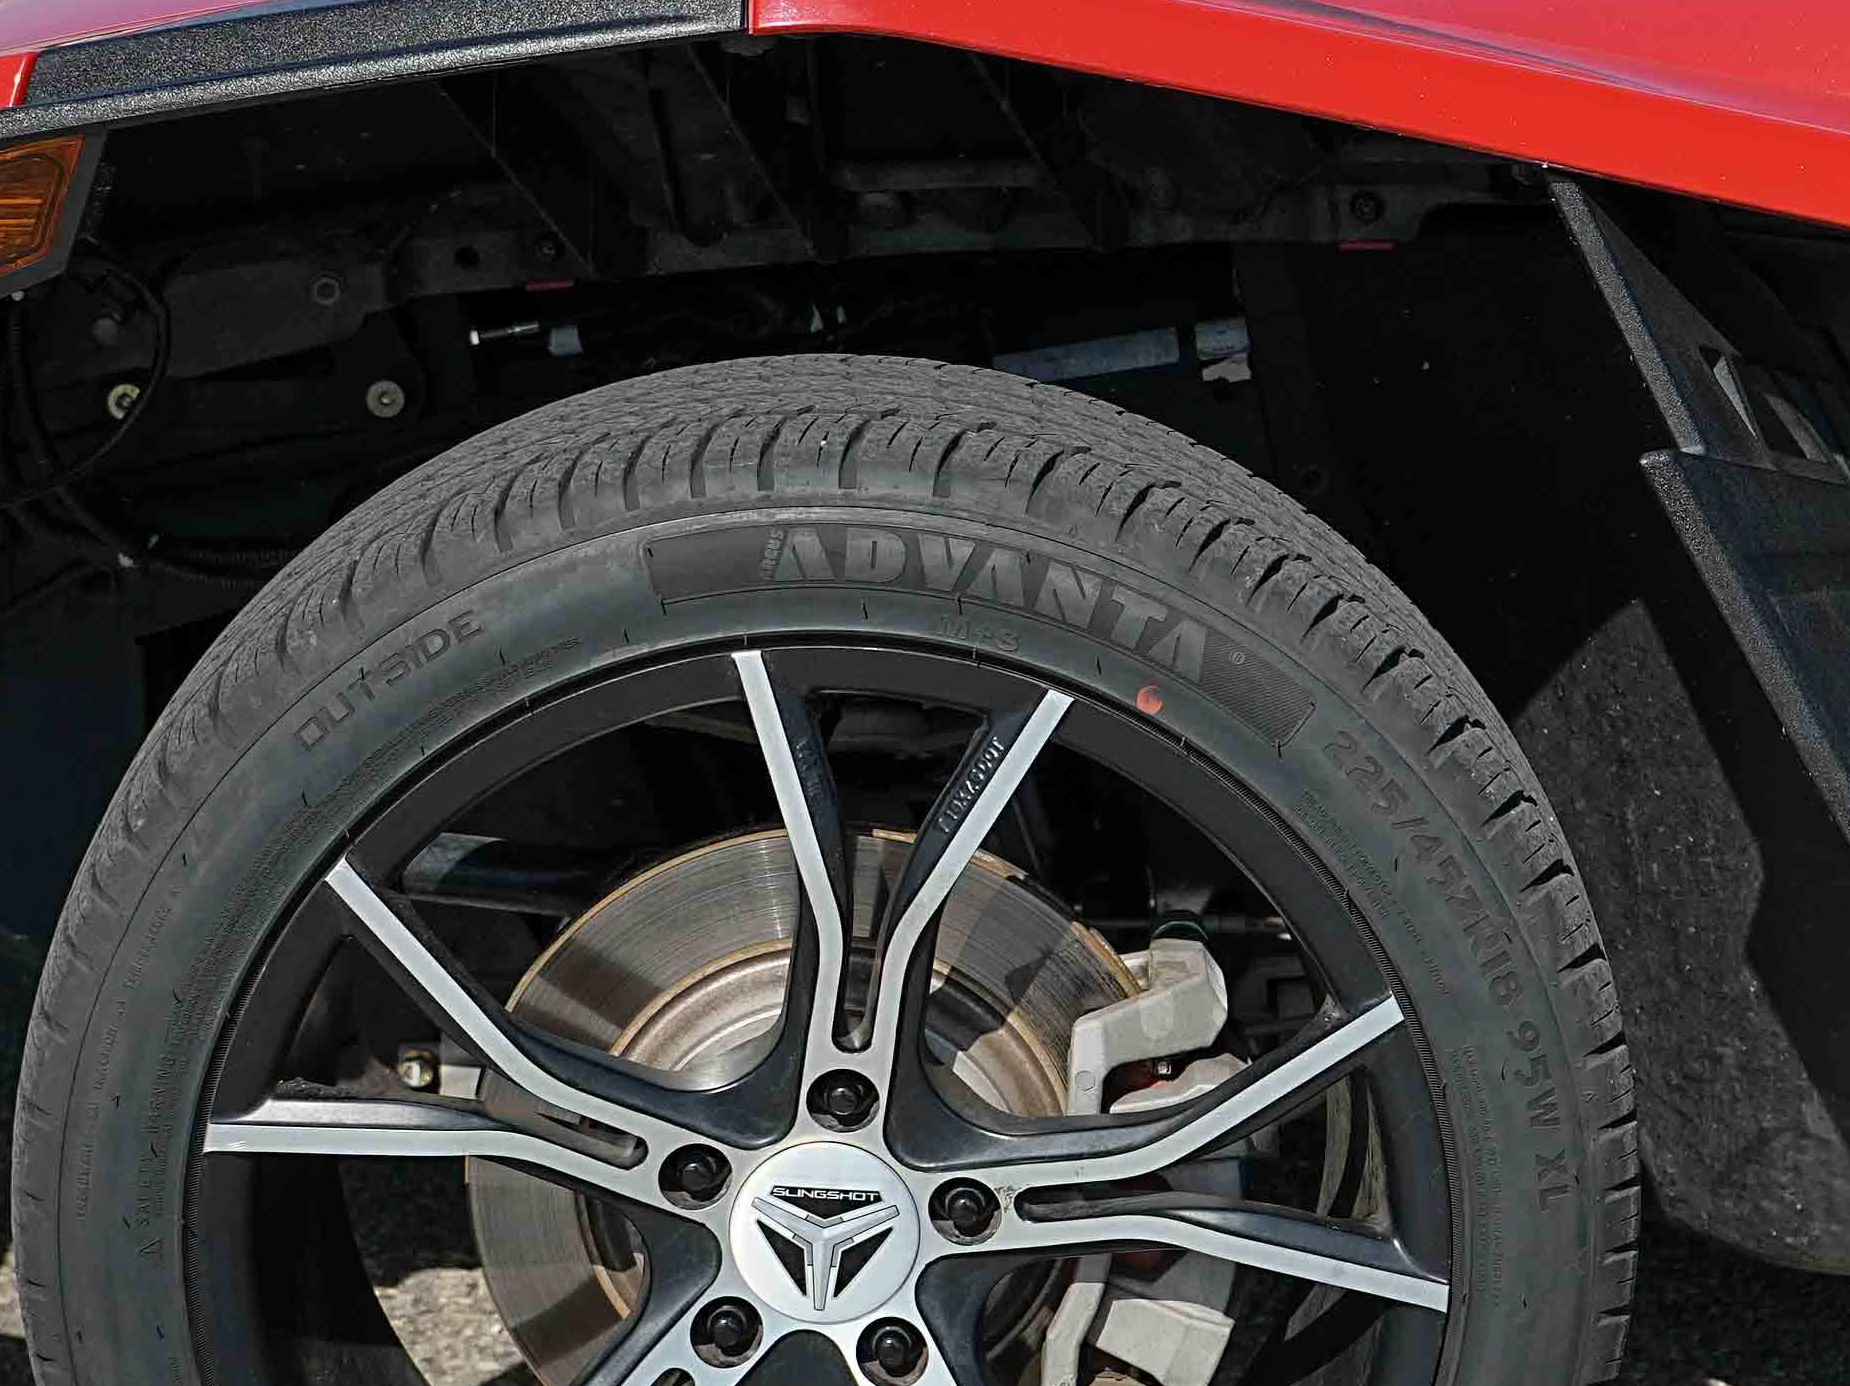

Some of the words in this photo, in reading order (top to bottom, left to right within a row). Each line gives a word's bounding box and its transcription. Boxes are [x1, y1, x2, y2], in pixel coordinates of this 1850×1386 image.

[773, 525, 1209, 683] ADVANTA
[293, 609, 483, 751] OUTSIDE
[1506, 1019, 1561, 1129] 95W
[1538, 1149, 1571, 1213] XL
[772, 1187, 880, 1202] SLINGSHOT
